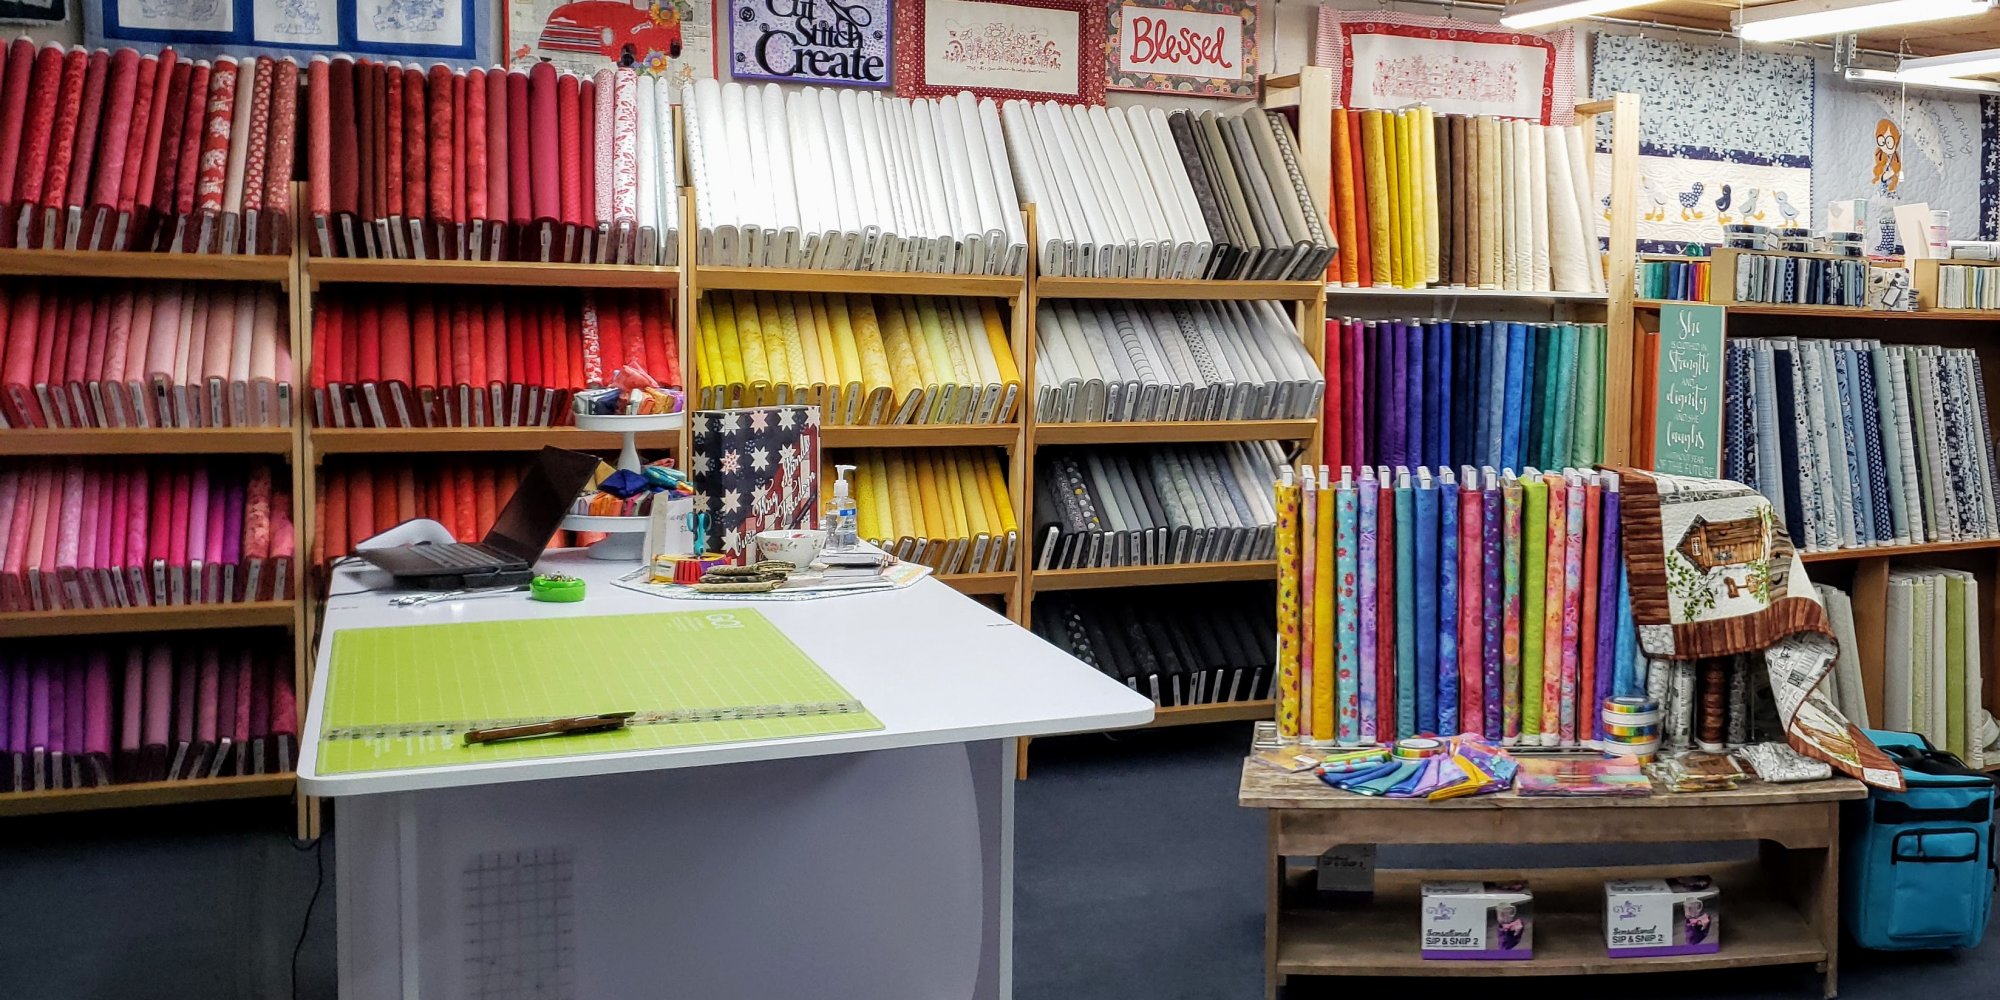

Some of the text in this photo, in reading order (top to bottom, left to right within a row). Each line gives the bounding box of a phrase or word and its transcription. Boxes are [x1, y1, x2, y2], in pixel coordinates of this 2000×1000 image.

[765, 0, 817, 20] Cut
[795, 16, 863, 48] Stitch
[1130, 16, 1232, 68] Blessed
[755, 30, 884, 81] Create
[1678, 309, 1700, 340] She
[1666, 382, 1708, 415] dignity
[1667, 420, 1705, 453] laughs
[1425, 937, 1441, 945] SIP
[1441, 937, 1448, 945] &
[1449, 937, 1471, 945] SNIP
[1612, 935, 1627, 943] SIP
[1635, 935, 1657, 943] SNIP
